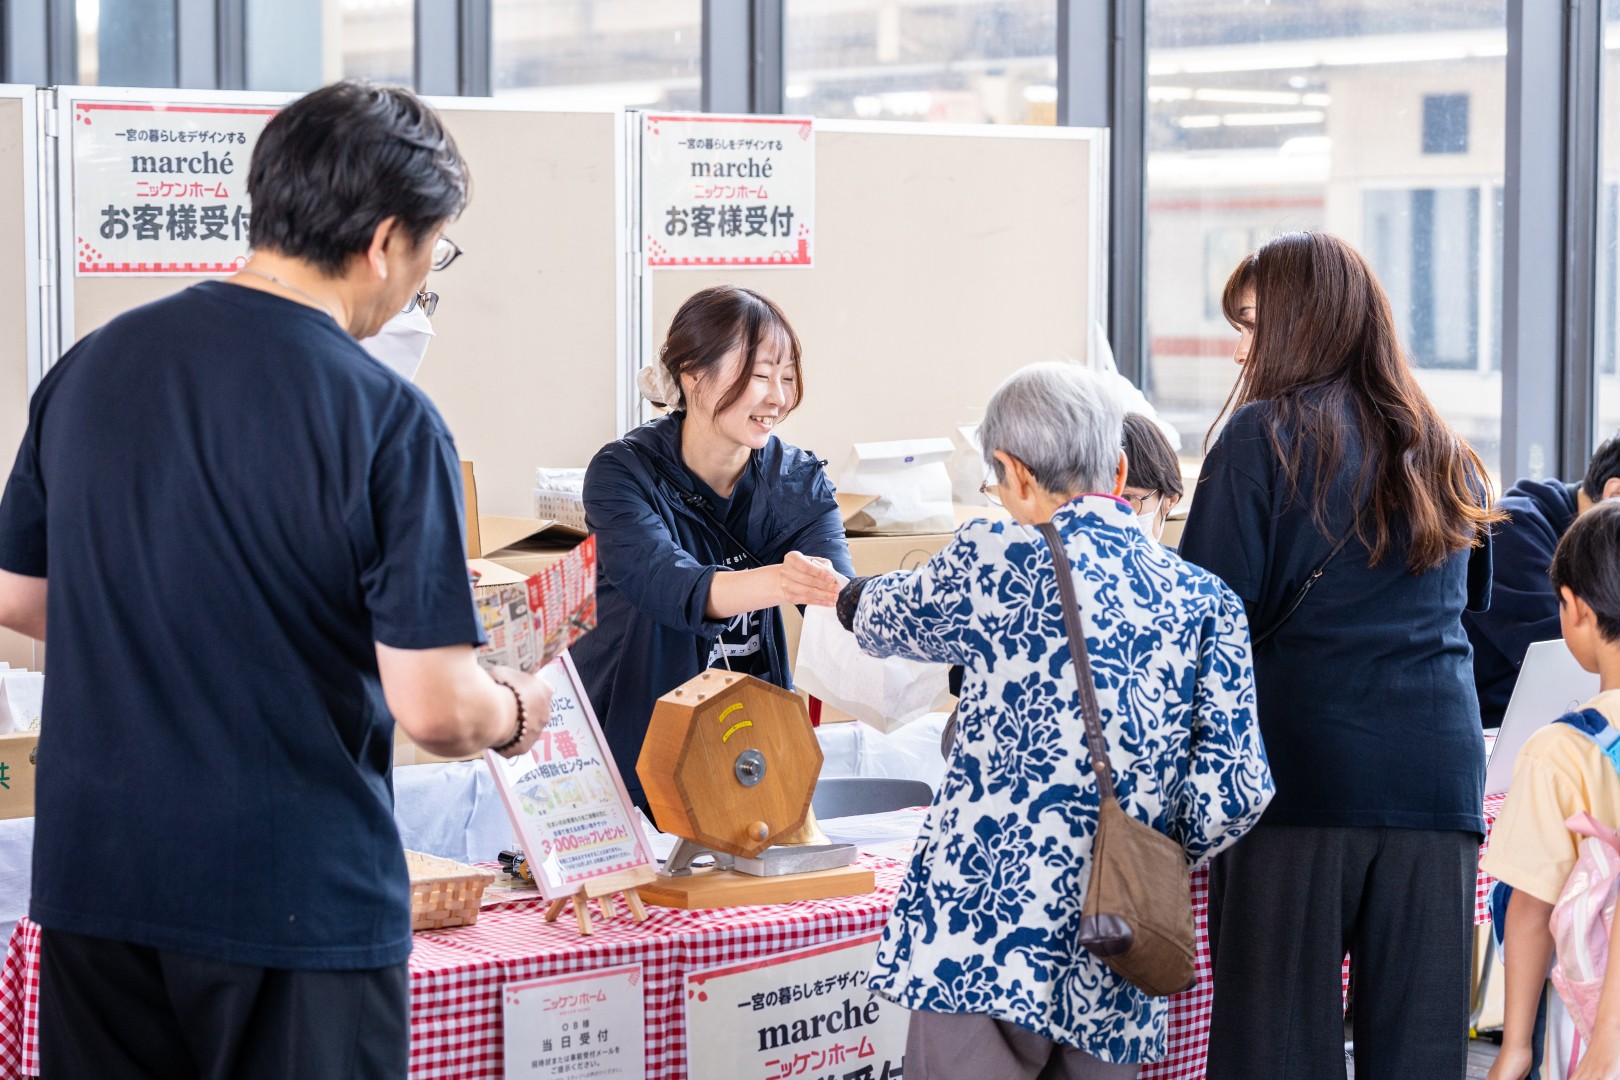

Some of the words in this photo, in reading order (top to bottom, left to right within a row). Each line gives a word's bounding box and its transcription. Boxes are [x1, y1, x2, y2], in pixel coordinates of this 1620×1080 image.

[115, 128, 247, 145] 一宮の暮らしをデザインする
[678, 138, 783, 151] 一宮の暮らしをデザインする
[131, 151, 234, 174] marché
[691, 157, 773, 178] marché
[136, 181, 229, 198] ニッケンホーム
[694, 184, 768, 199] ニッケンホーム
[665, 204, 794, 237] お客様受付
[542, 989, 607, 1012] ニッケンホーム
[757, 993, 880, 1052] marché
[765, 1035, 875, 1080] ニッケンホーム
